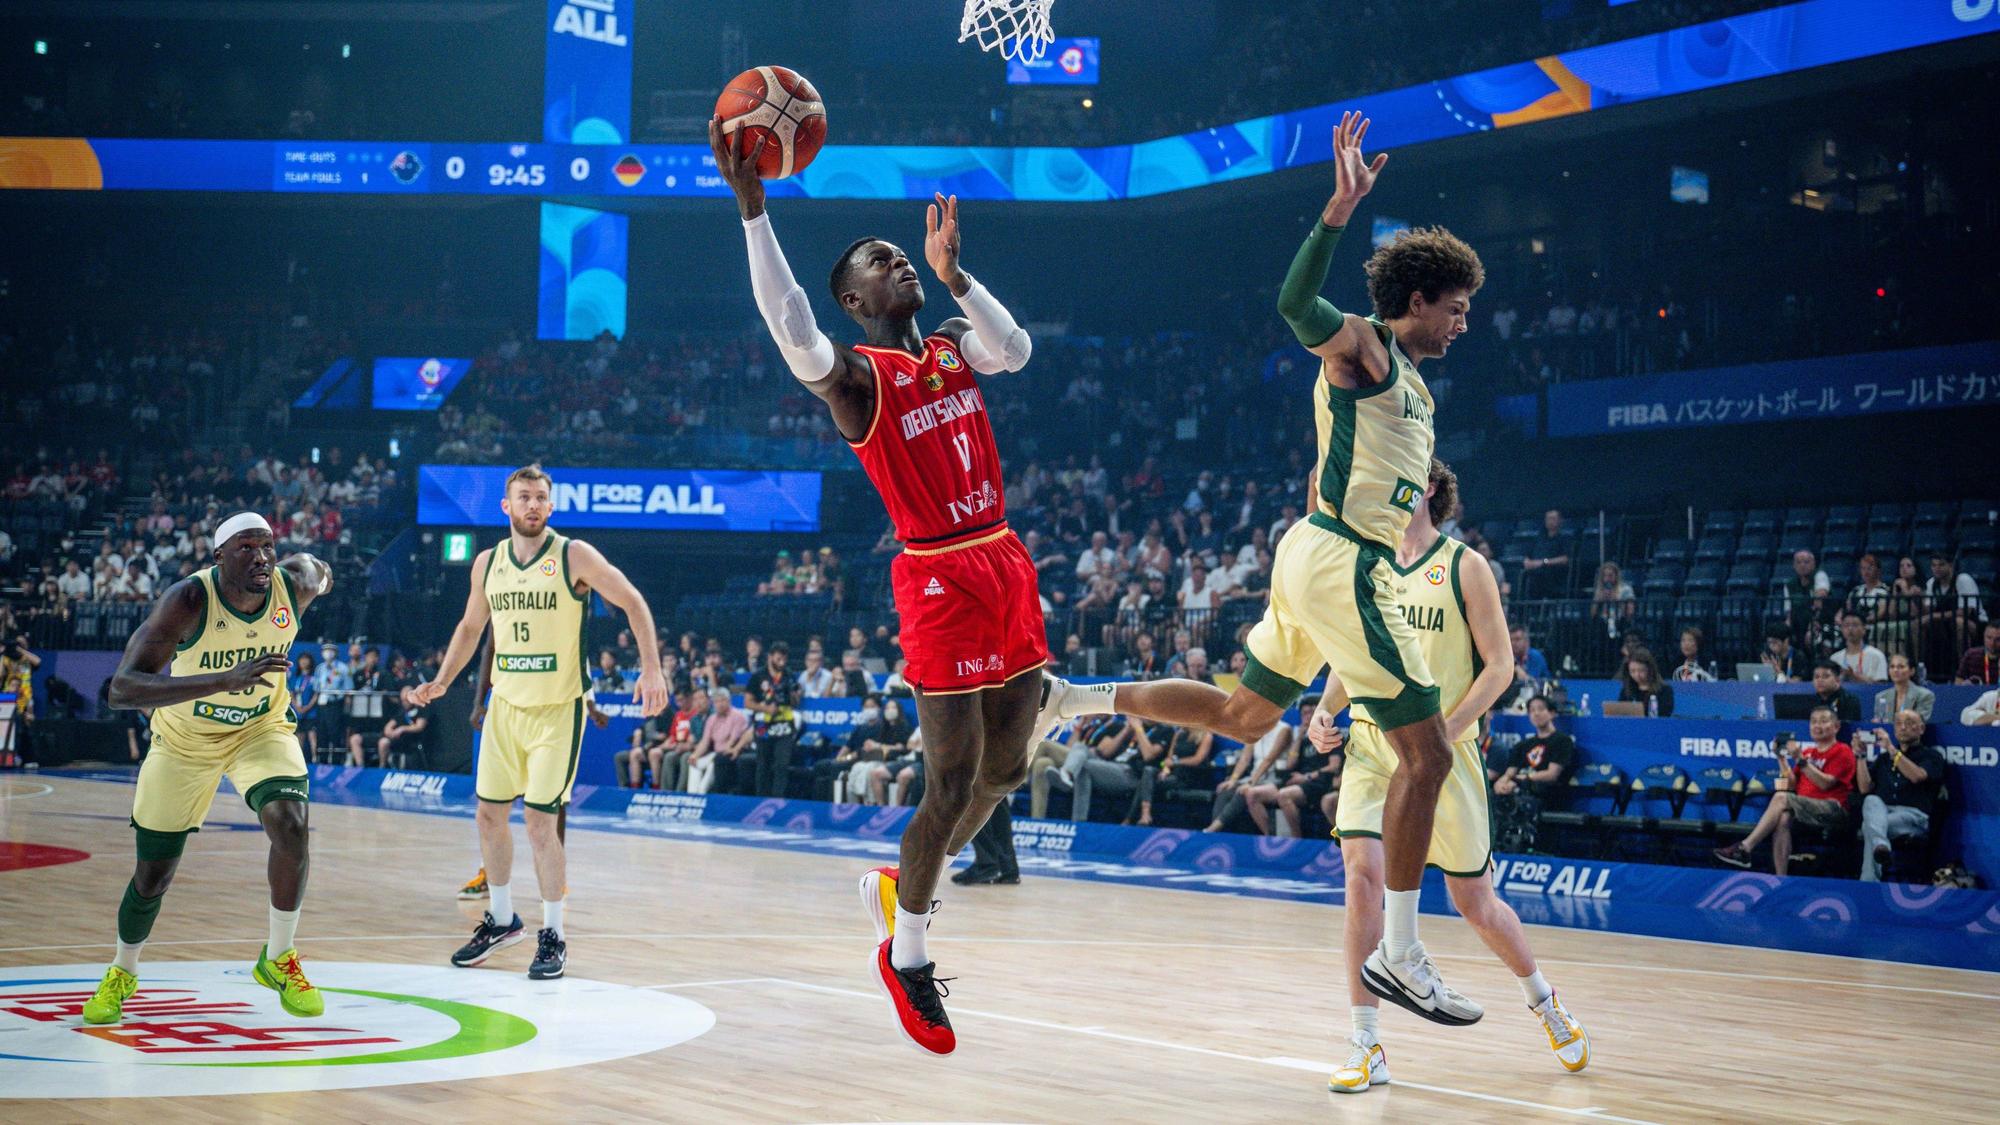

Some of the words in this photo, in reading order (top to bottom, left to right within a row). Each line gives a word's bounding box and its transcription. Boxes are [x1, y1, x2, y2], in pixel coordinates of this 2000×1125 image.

[553, 4, 627, 47] ALL
[445, 156, 465, 180] 0
[489, 164, 545, 186] 9:45
[570, 158, 590, 180] 0
[1608, 403, 1668, 427] FIBA
[1675, 387, 1840, 424] バスケットボール
[953, 432, 971, 472] 17
[550, 483, 589, 512] IN
[592, 484, 643, 503] FOR
[644, 484, 725, 515] ALL
[947, 490, 986, 525] ING
[490, 592, 557, 611] AUSTRALIA
[924, 586, 945, 596] PEAK
[513, 622, 529, 642] 15
[507, 656, 554, 669] SIGNET
[956, 658, 983, 676] ING
[213, 700, 267, 723] SIGNT
[825, 711, 849, 725] CUP
[1680, 737, 1732, 757] FIBA
[1011, 820, 1077, 837] ASKETBALL
[1012, 833, 1038, 848] CUP
[1038, 836, 1073, 851] 2023
[1509, 862, 1551, 882] FOR
[1547, 865, 1612, 898] ALL
